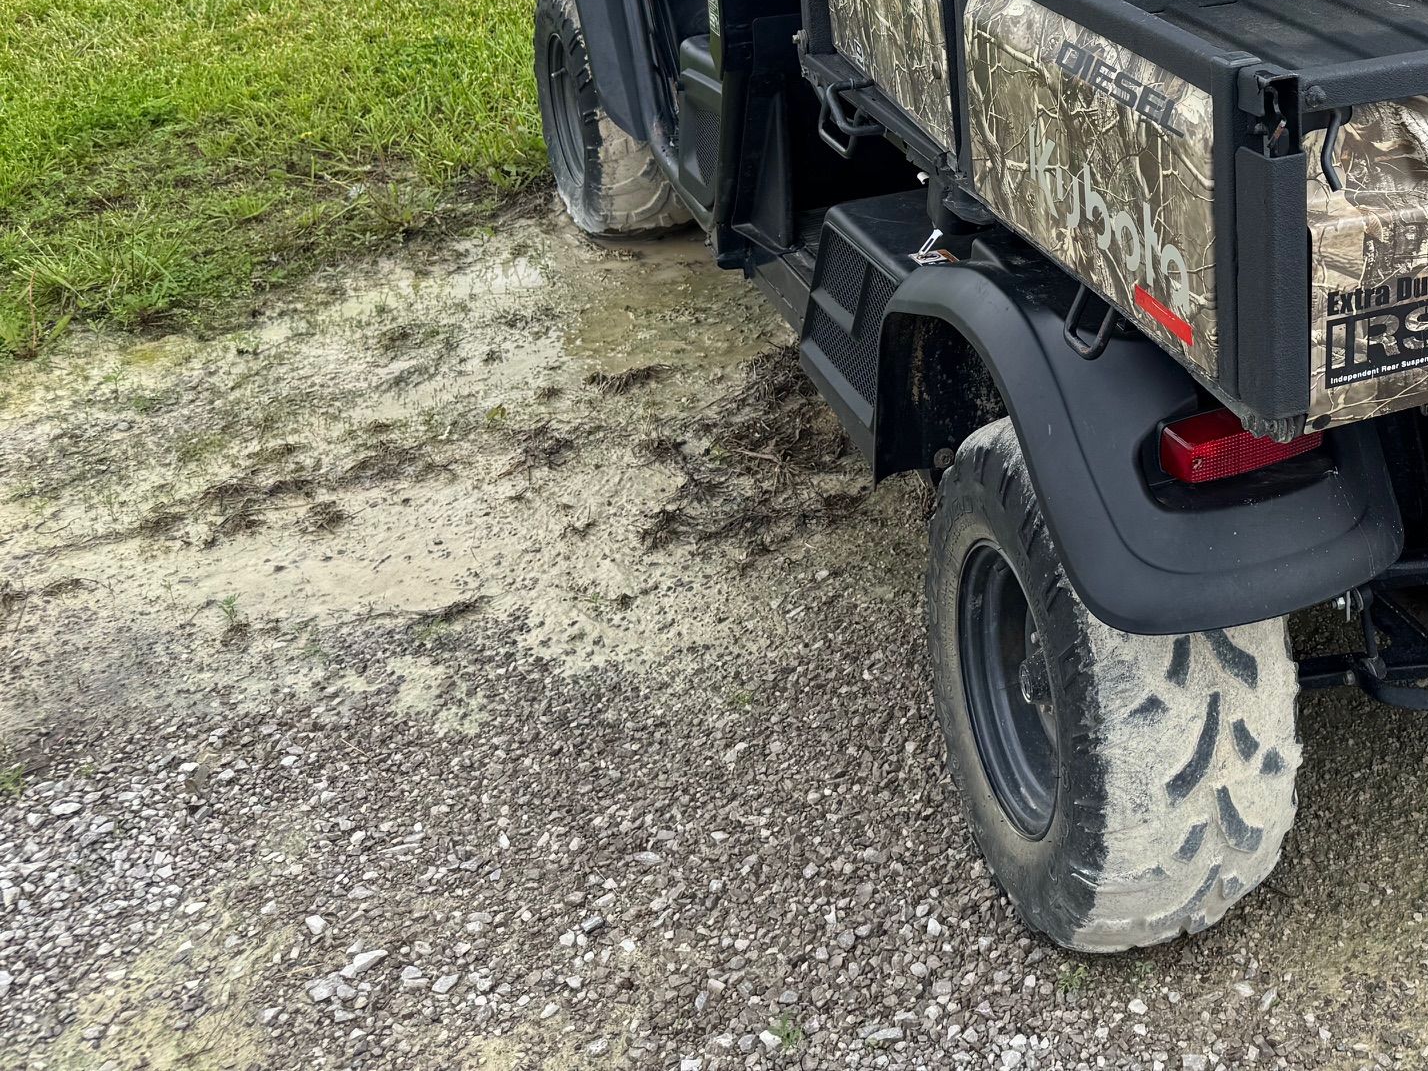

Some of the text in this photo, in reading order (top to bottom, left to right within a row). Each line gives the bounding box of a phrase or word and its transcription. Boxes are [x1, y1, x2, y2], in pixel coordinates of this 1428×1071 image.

[1055, 39, 1184, 139] DIESEL
[1029, 125, 1191, 315] Kubota
[1327, 284, 1390, 317] Extra
[1330, 367, 1379, 385] Independent
[1381, 362, 1400, 372] Rear
